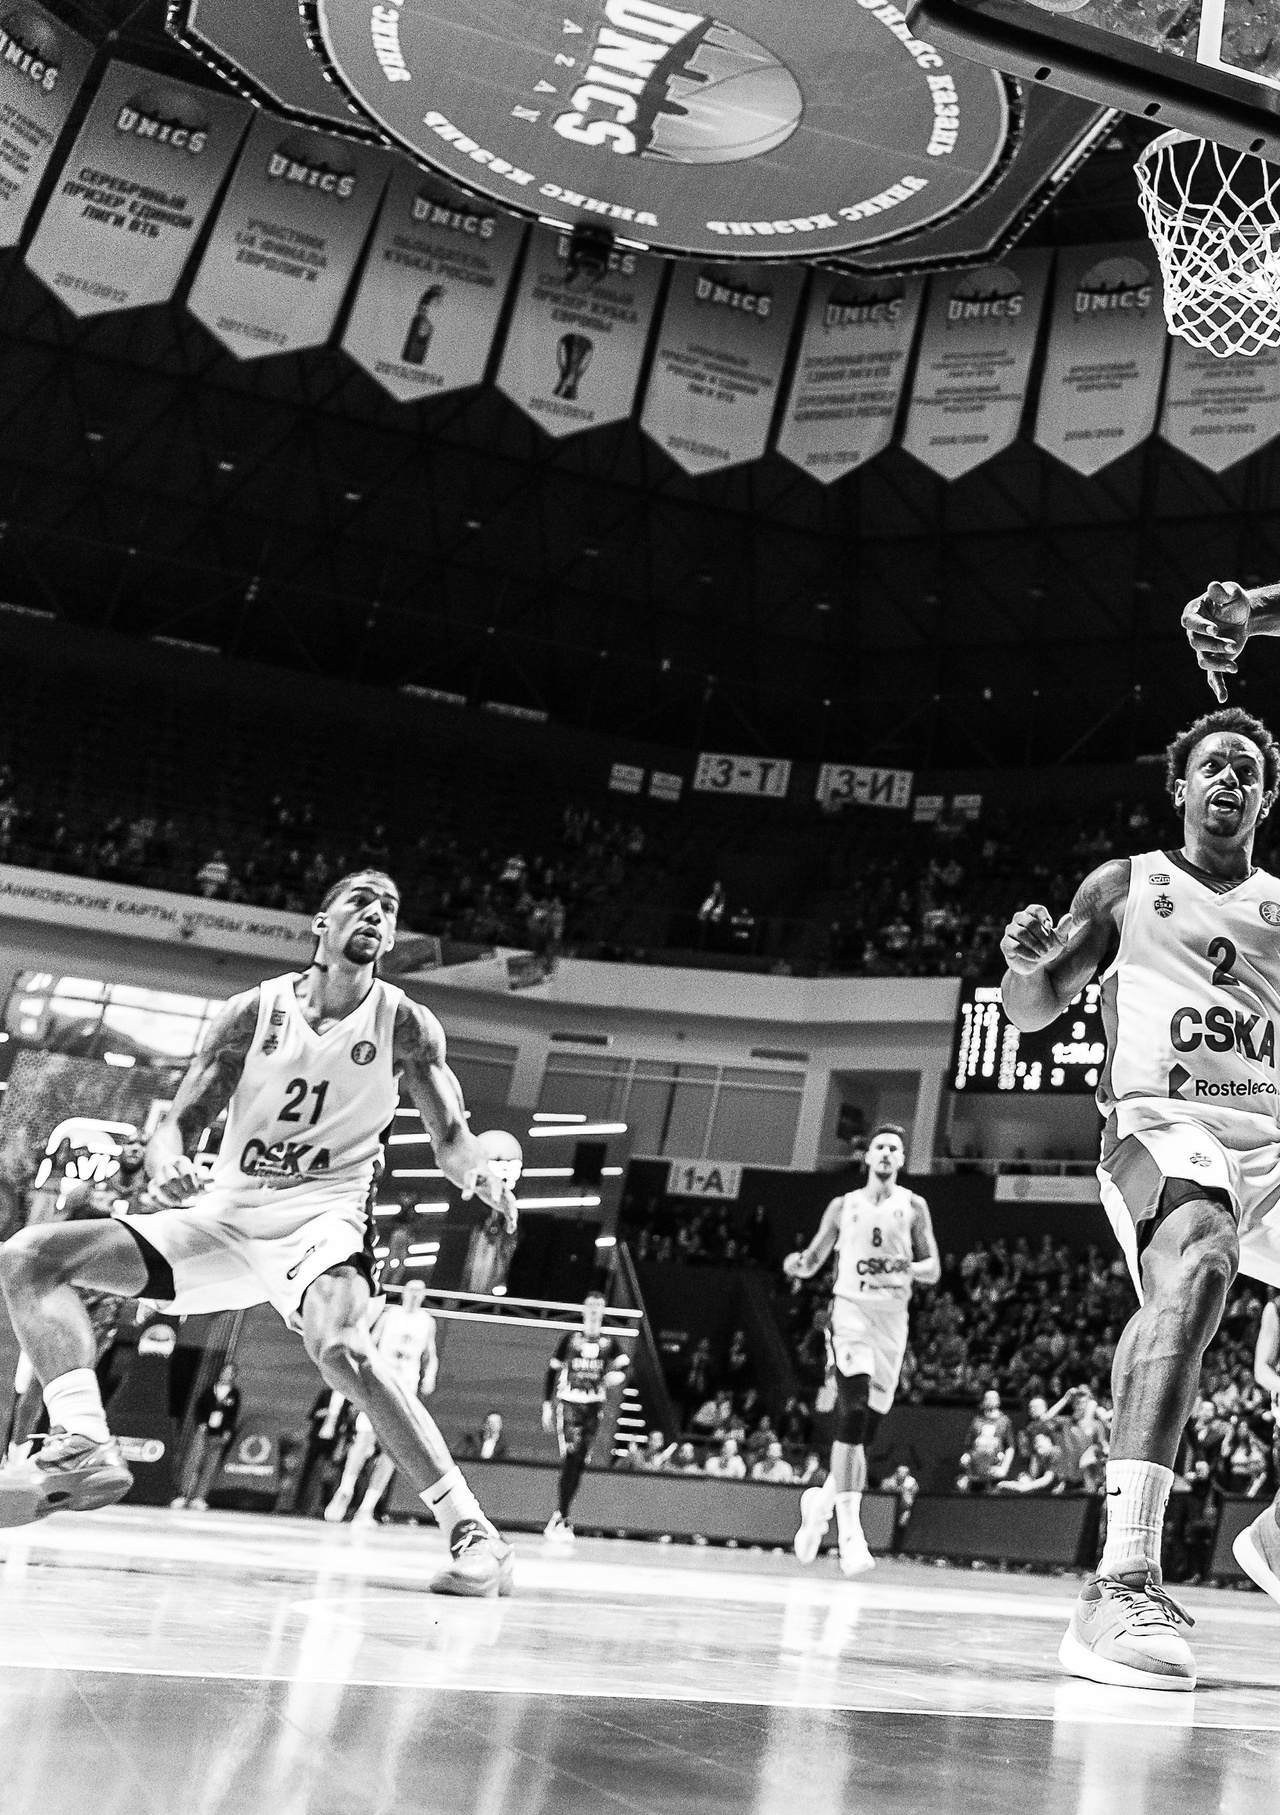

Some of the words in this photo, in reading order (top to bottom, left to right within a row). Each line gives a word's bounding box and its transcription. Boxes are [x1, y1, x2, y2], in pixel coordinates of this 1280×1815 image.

[553, 0, 706, 155] UNICS
[116, 108, 208, 153] UNICS
[268, 153, 356, 198] UNICS
[412, 197, 497, 239] UNICS
[695, 276, 772, 317] UNICS
[825, 300, 902, 327] UNICS
[947, 295, 1024, 320] UNICS
[1075, 286, 1153, 313] UNICS
[1155, 902, 1173, 910] CSKA
[1207, 936, 1240, 987] 2
[1170, 1006, 1275, 1069] CSKA
[277, 1077, 330, 1125] 21
[239, 1138, 331, 1176] CSKA
[873, 1227, 882, 1247] 8
